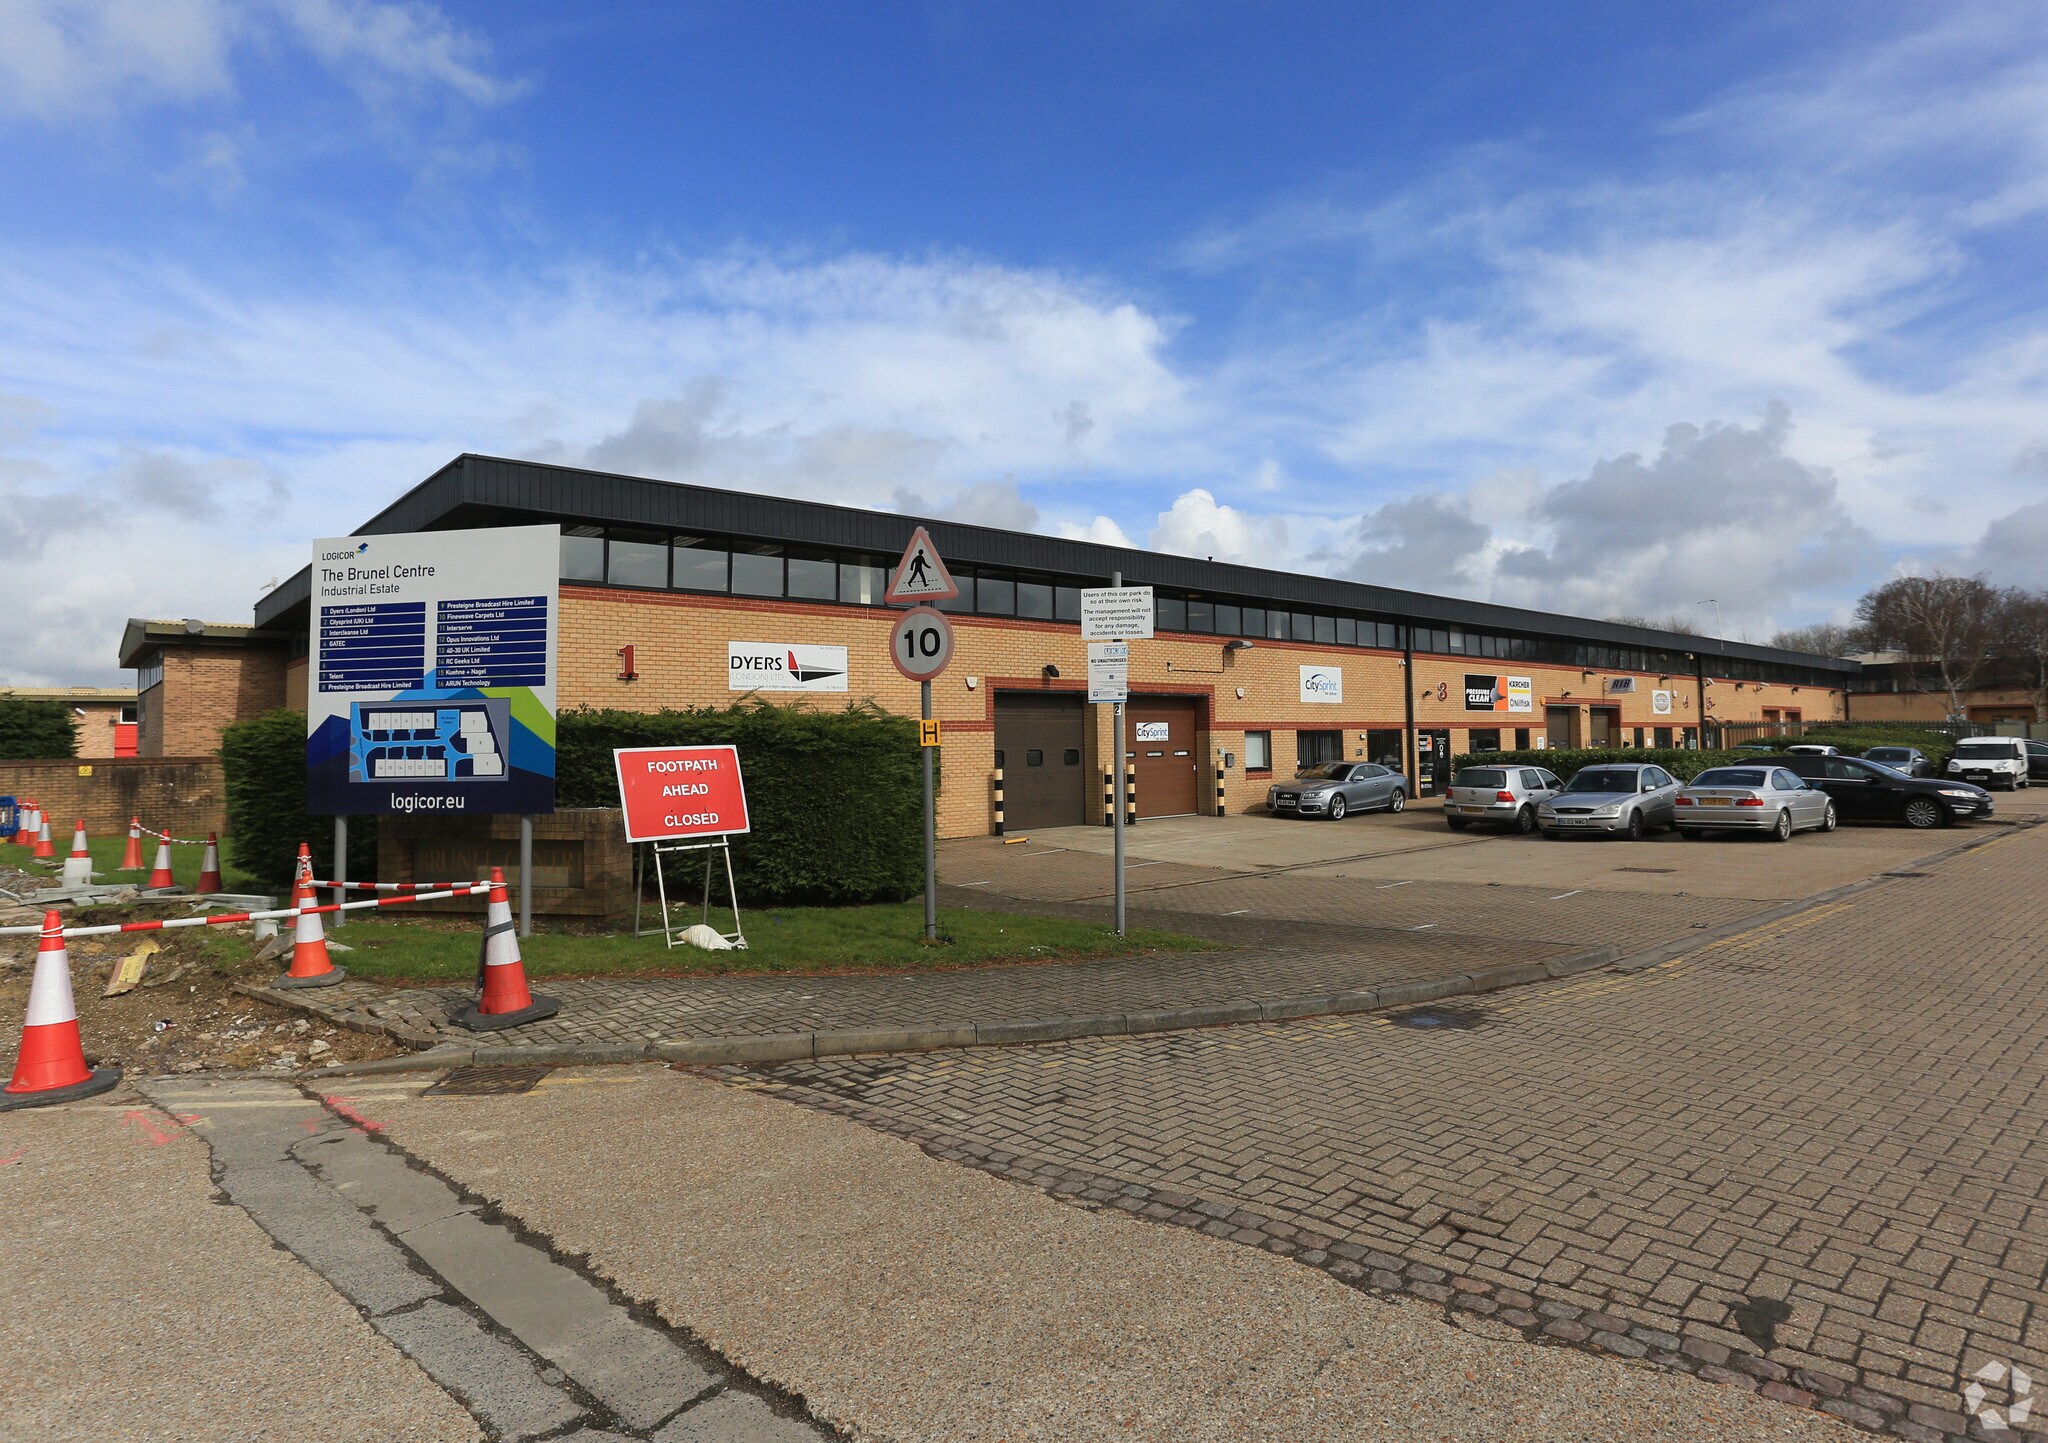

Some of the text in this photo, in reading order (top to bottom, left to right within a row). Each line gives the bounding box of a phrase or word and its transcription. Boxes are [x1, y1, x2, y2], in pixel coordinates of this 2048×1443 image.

[322, 551, 355, 561] LOGICOR
[321, 565, 435, 582] The Brunel Centre
[321, 583, 400, 596] Industrial Estate
[474, 612, 495, 620] Carpets
[446, 636, 460, 644] Opus
[904, 627, 941, 659] 10
[617, 644, 639, 678] 1
[731, 656, 782, 670] DYERS
[471, 668, 487, 676] Nagel
[1306, 680, 1337, 692] CitySprint
[1438, 681, 1447, 701] 3
[1469, 694, 1490, 702] CLEAN
[1115, 705, 1120, 715] 2
[923, 722, 938, 744] H
[1137, 728, 1168, 738] CitySprint
[647, 759, 718, 773] FOOTPATH
[662, 783, 709, 797] AHEAD
[391, 792, 465, 813] logicor.eu
[664, 812, 719, 827] CLOSED
